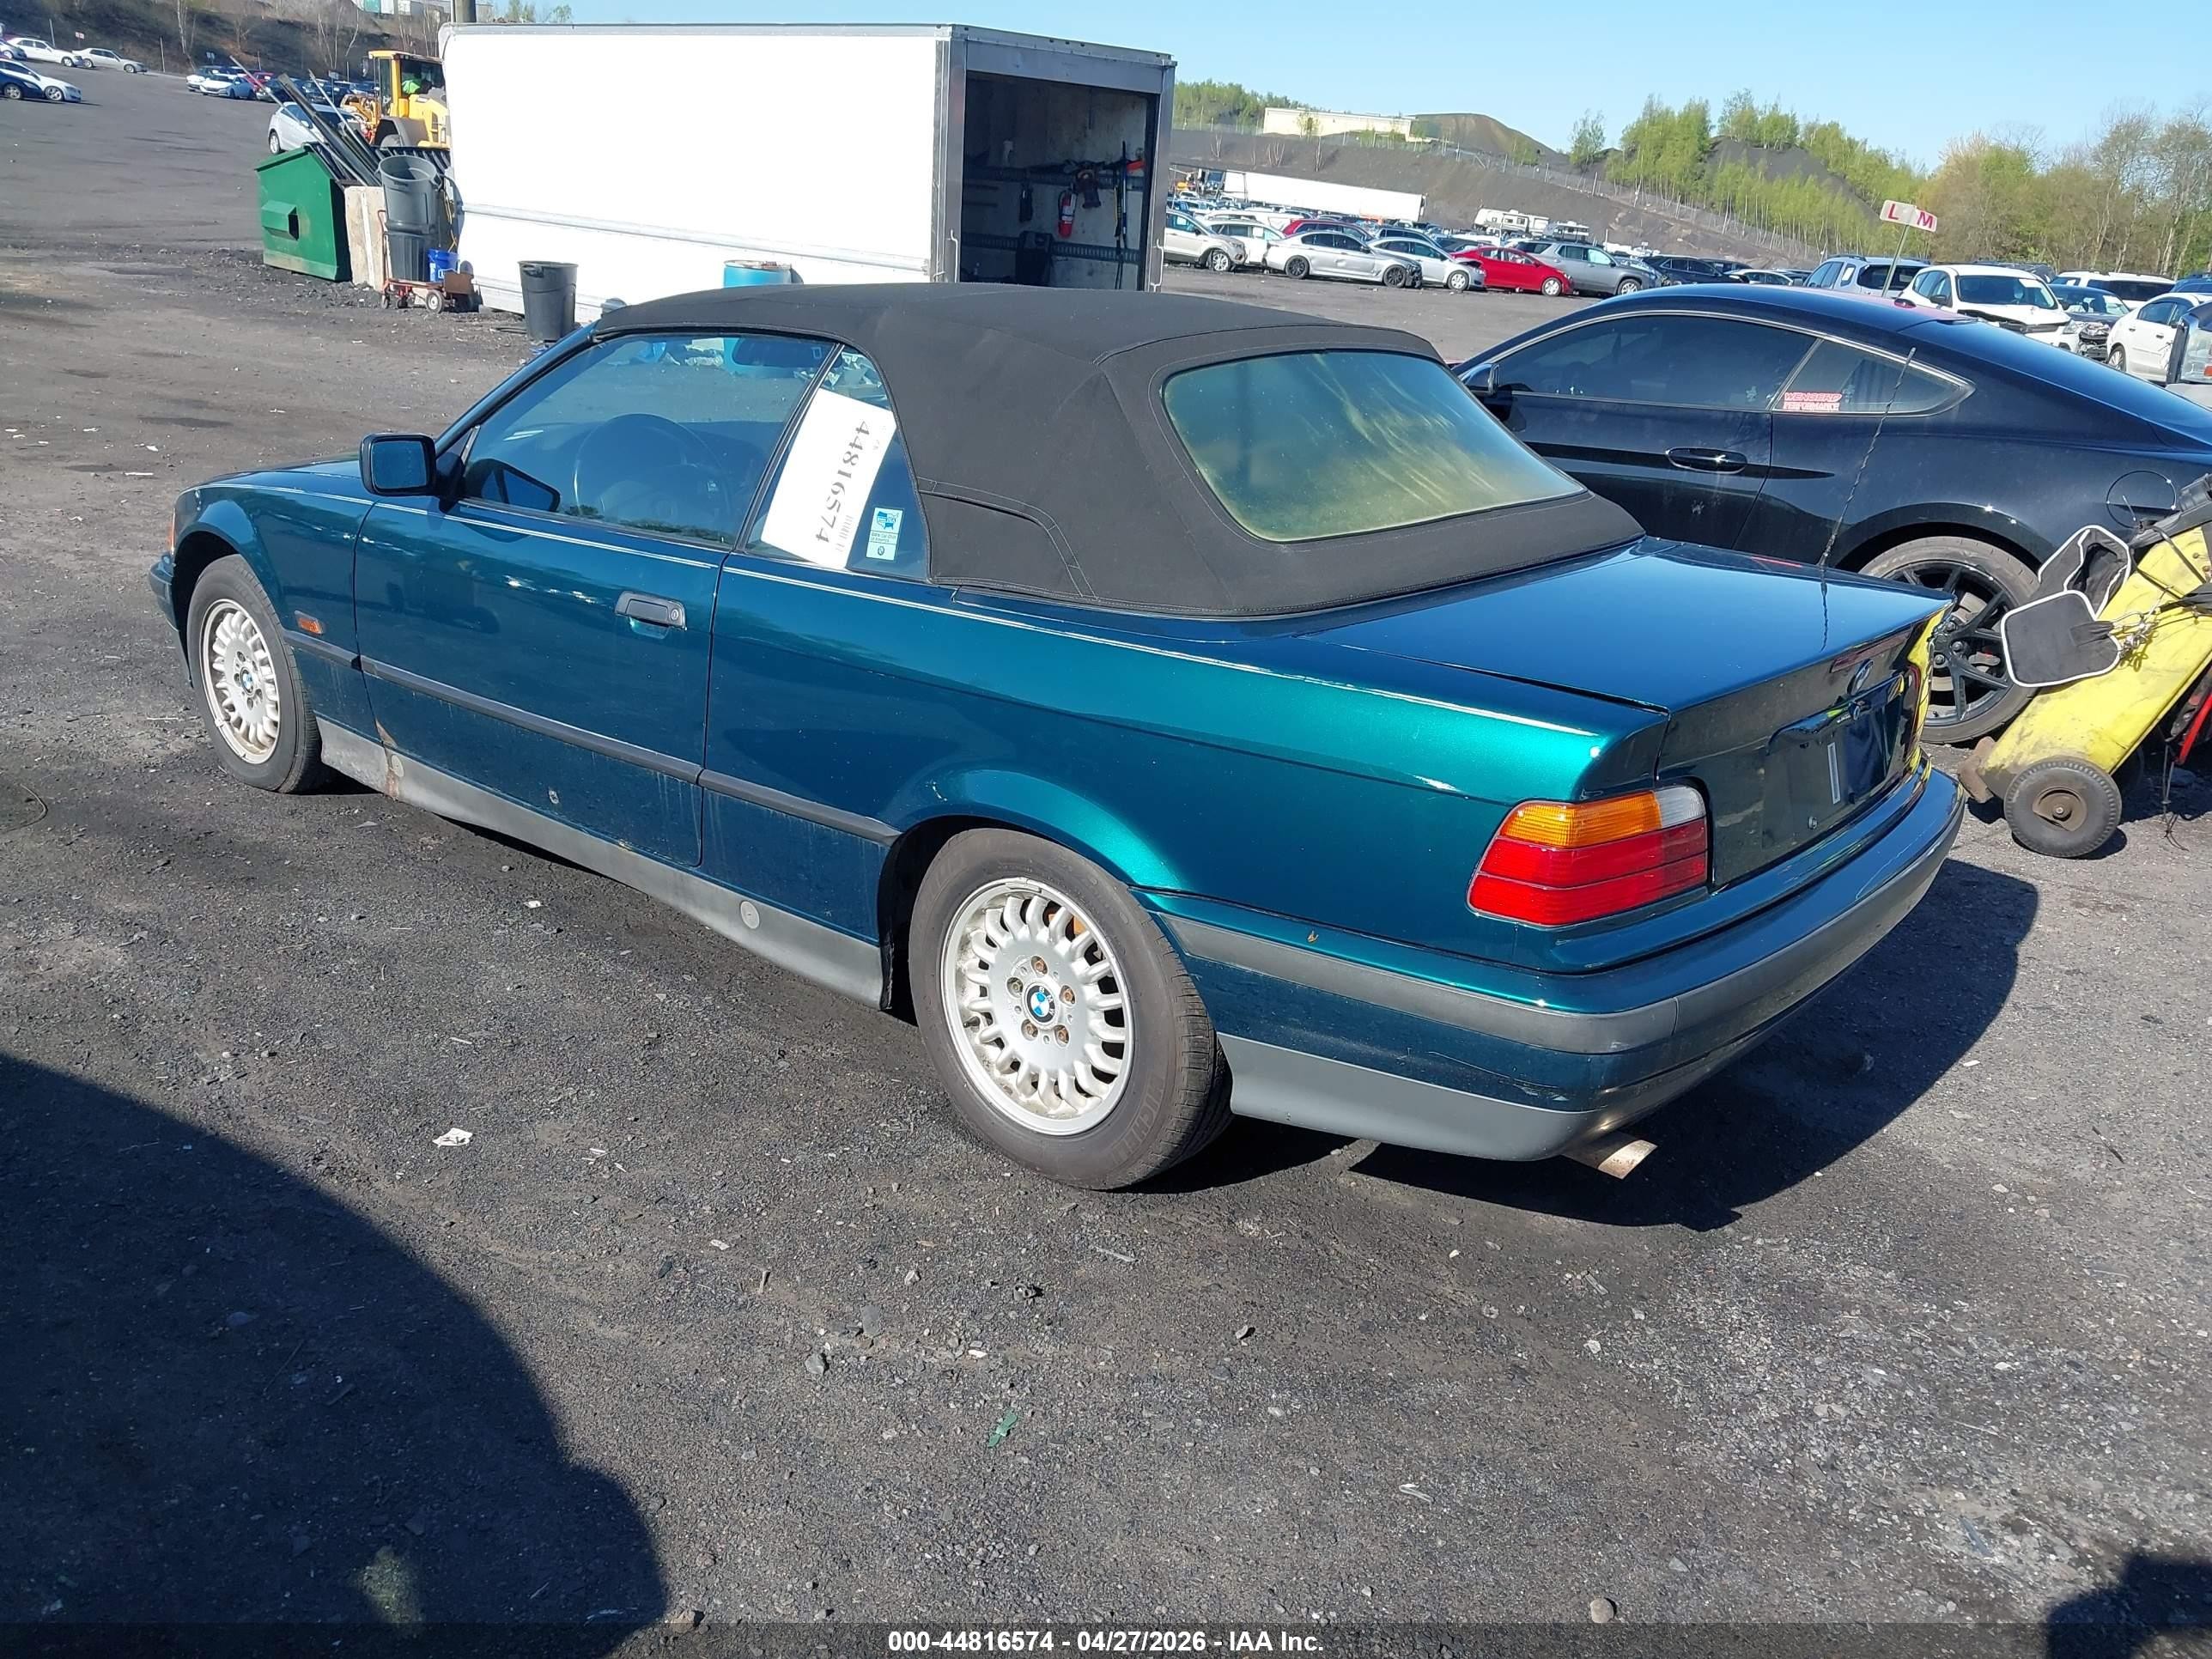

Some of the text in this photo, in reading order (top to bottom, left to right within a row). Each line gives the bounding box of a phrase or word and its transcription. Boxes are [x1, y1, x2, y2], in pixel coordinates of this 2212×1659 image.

[1888, 204, 1899, 220] L
[1917, 211, 1934, 228] M
[816, 421, 870, 543] 44816574
